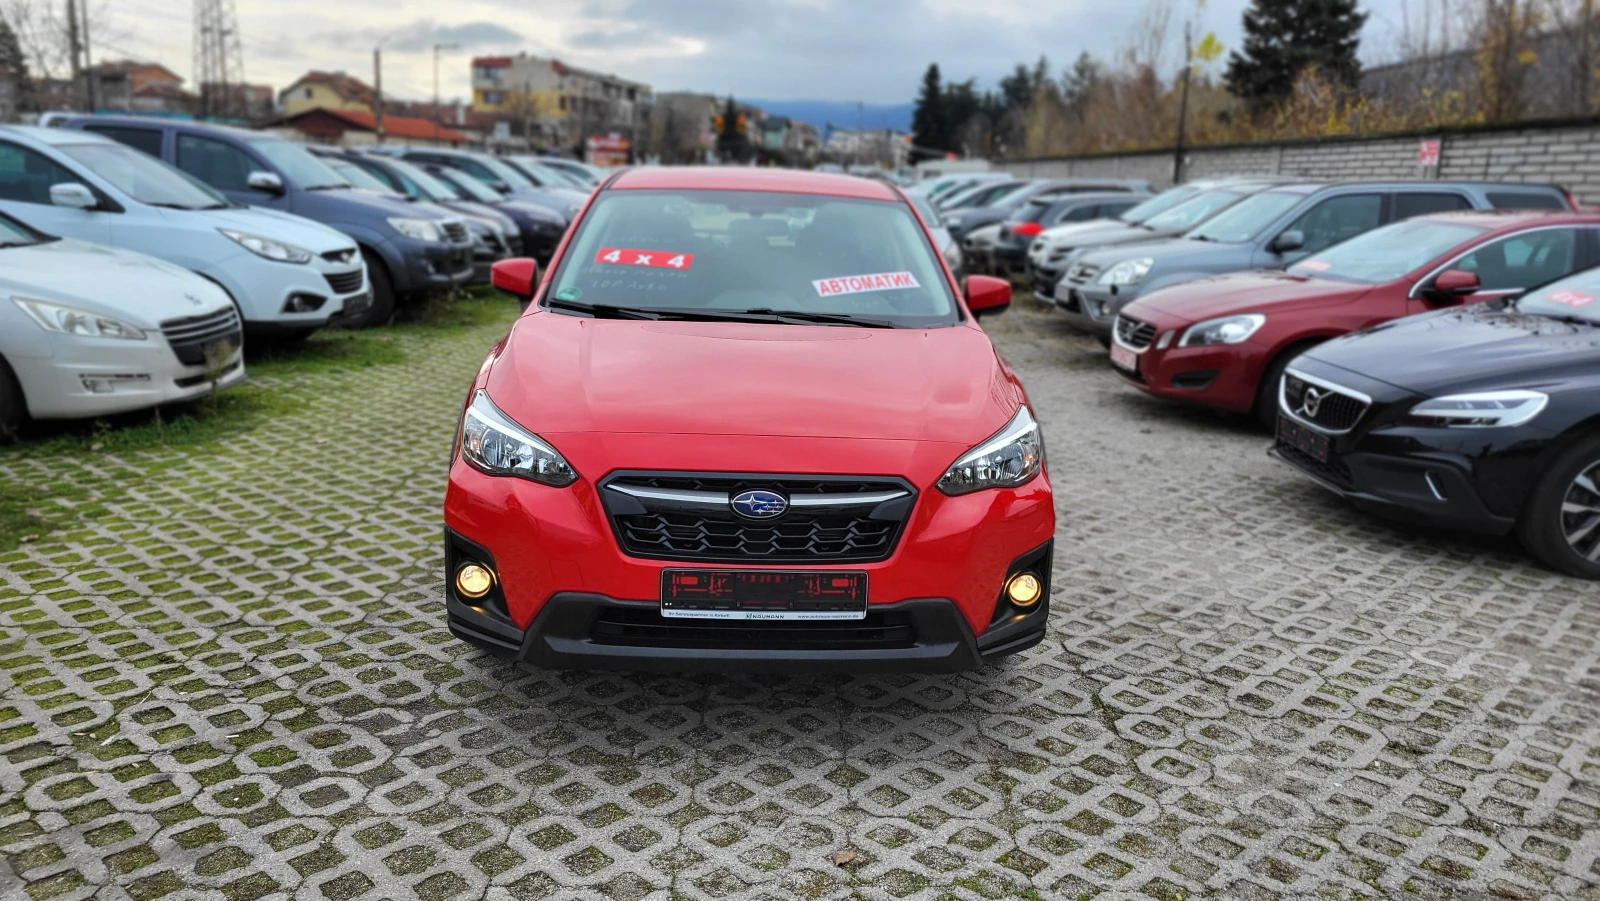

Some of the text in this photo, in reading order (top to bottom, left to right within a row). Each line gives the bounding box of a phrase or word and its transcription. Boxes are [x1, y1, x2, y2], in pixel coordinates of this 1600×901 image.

[603, 250, 621, 263] 4
[667, 254, 685, 268] 4
[819, 273, 914, 295] АВТОМАТИК
